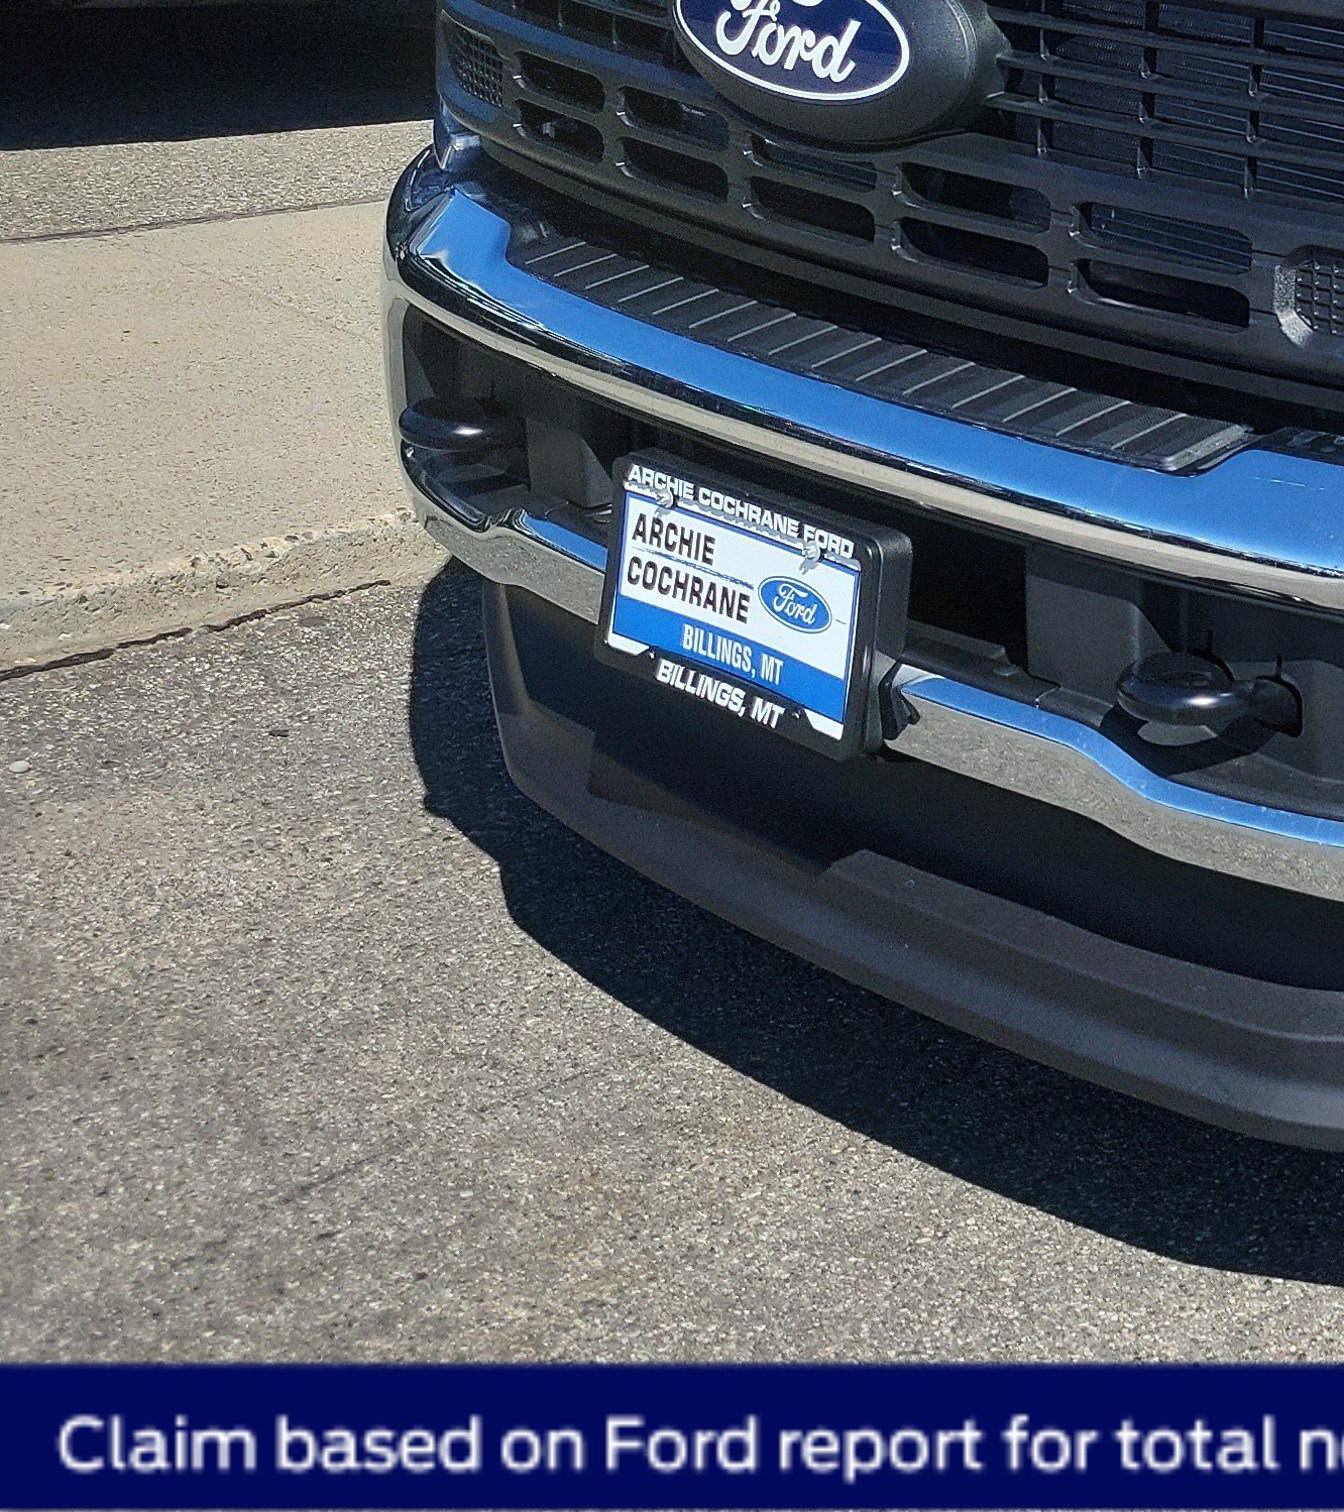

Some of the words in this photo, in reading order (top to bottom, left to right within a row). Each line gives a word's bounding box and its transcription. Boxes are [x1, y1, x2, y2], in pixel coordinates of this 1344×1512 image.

[627, 464, 695, 500] ARCHIE
[698, 487, 800, 538] COCHRANE
[802, 524, 855, 559] FORD
[631, 513, 716, 567] ARCHIE
[627, 556, 751, 625] COCHRANE
[772, 580, 817, 627] Ford
[682, 624, 756, 679] BILLINGS,
[761, 653, 784, 686] MT
[655, 660, 746, 718] BILLINGS,
[750, 697, 786, 729] MT
